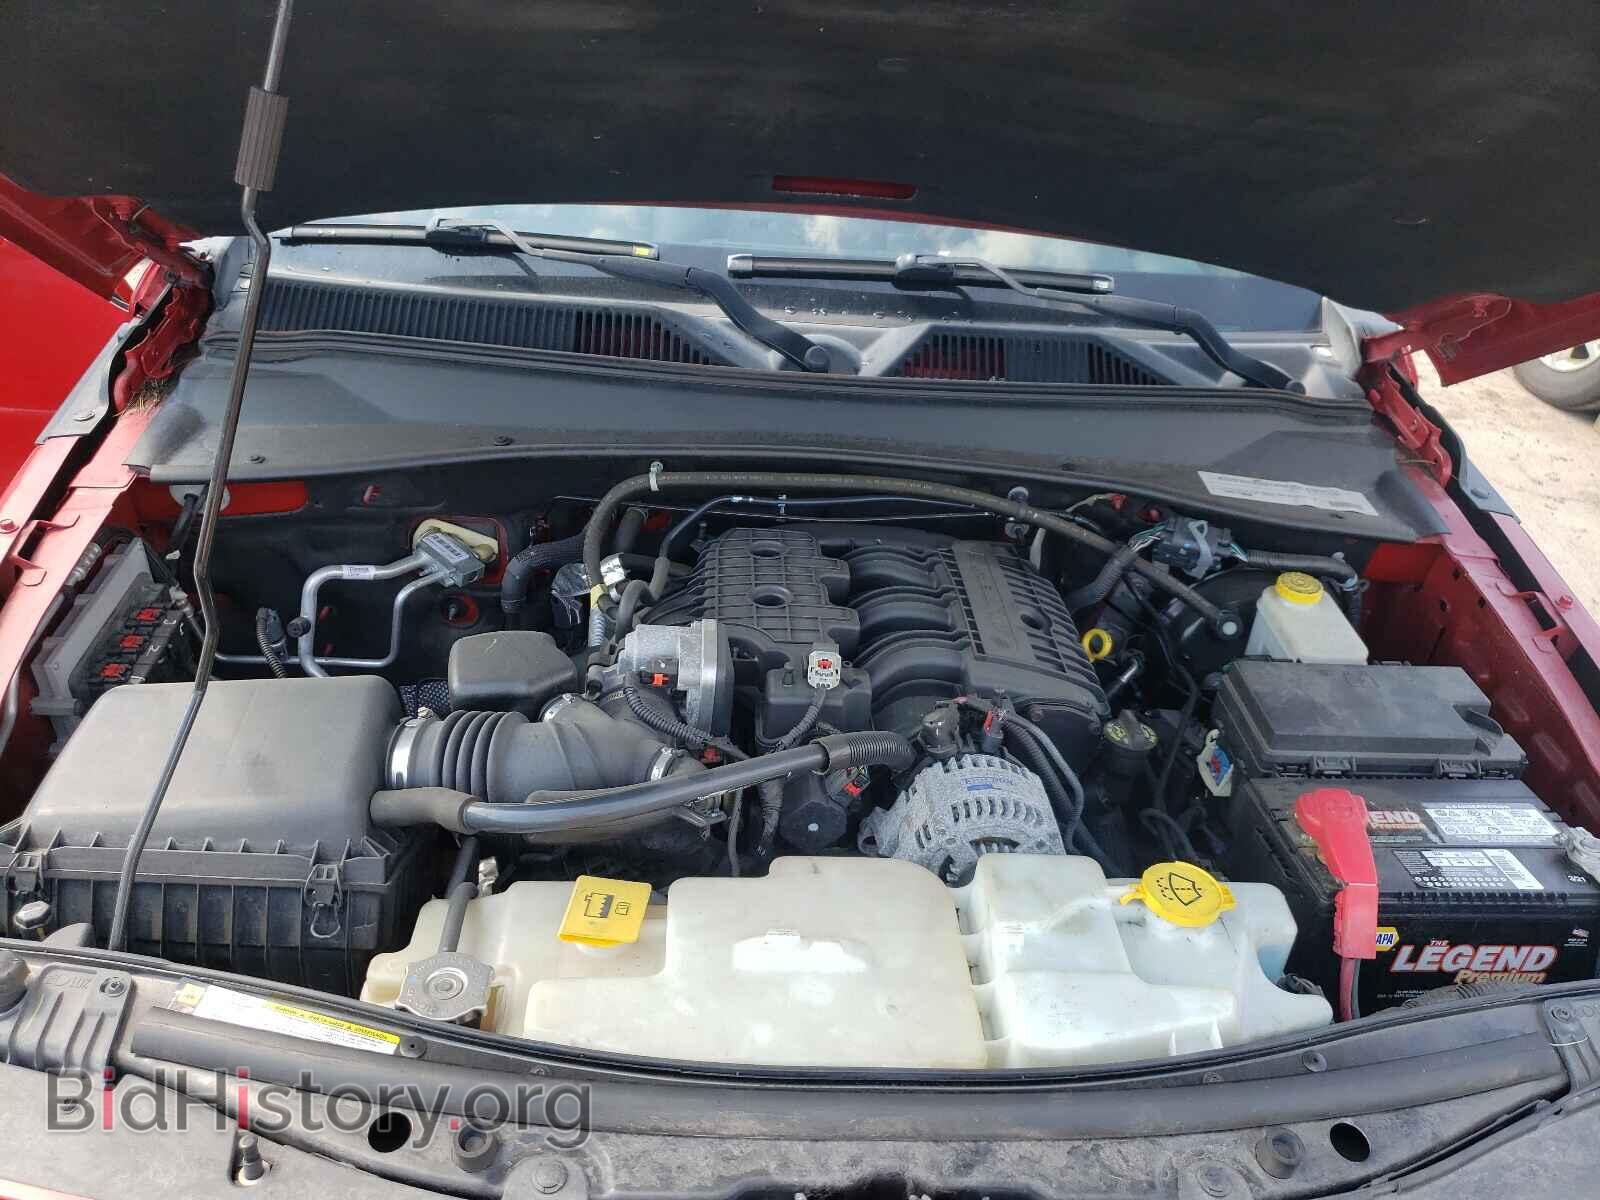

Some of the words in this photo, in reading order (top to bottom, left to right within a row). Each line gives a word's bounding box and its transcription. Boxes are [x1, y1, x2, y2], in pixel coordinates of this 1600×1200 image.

[1368, 809, 1420, 825] END
[1376, 933, 1394, 945] APA
[1430, 939, 1449, 947] THE
[1390, 944, 1558, 973] LEGEND
[1454, 969, 1548, 985] Premium
